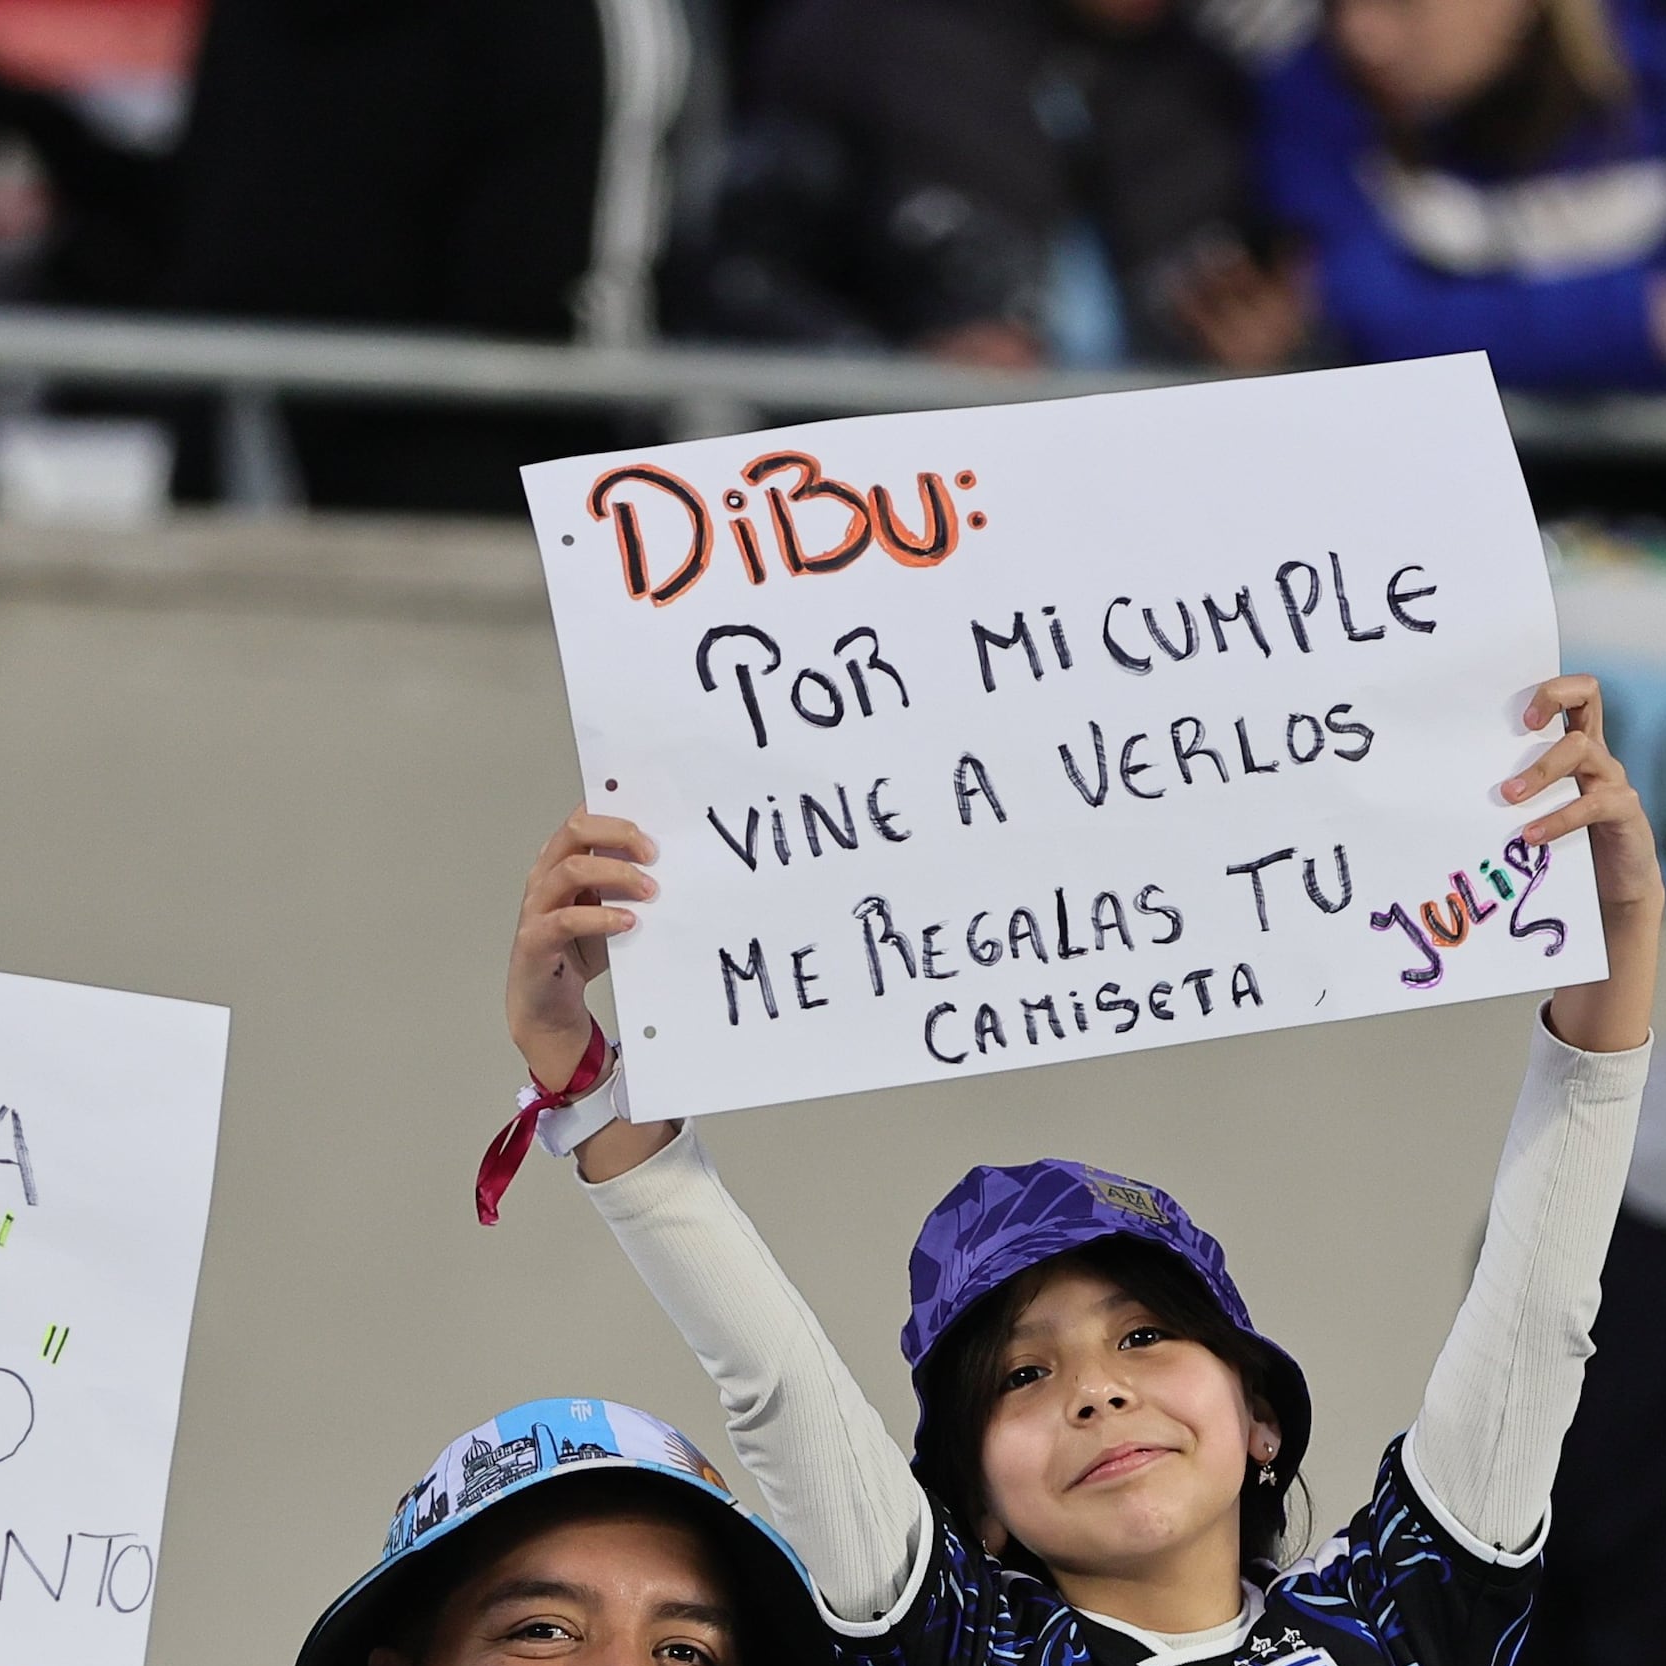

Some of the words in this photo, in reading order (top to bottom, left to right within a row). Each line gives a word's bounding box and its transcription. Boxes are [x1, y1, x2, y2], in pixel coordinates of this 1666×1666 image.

[696, 623, 910, 748] POR
[1101, 552, 1437, 676] CUMPLE
[953, 752, 1008, 826] A
[1058, 701, 1375, 808] VERLOS
[718, 937, 829, 1026] ME
[852, 883, 1184, 997] REGALAS
[1226, 844, 1352, 932] TU
